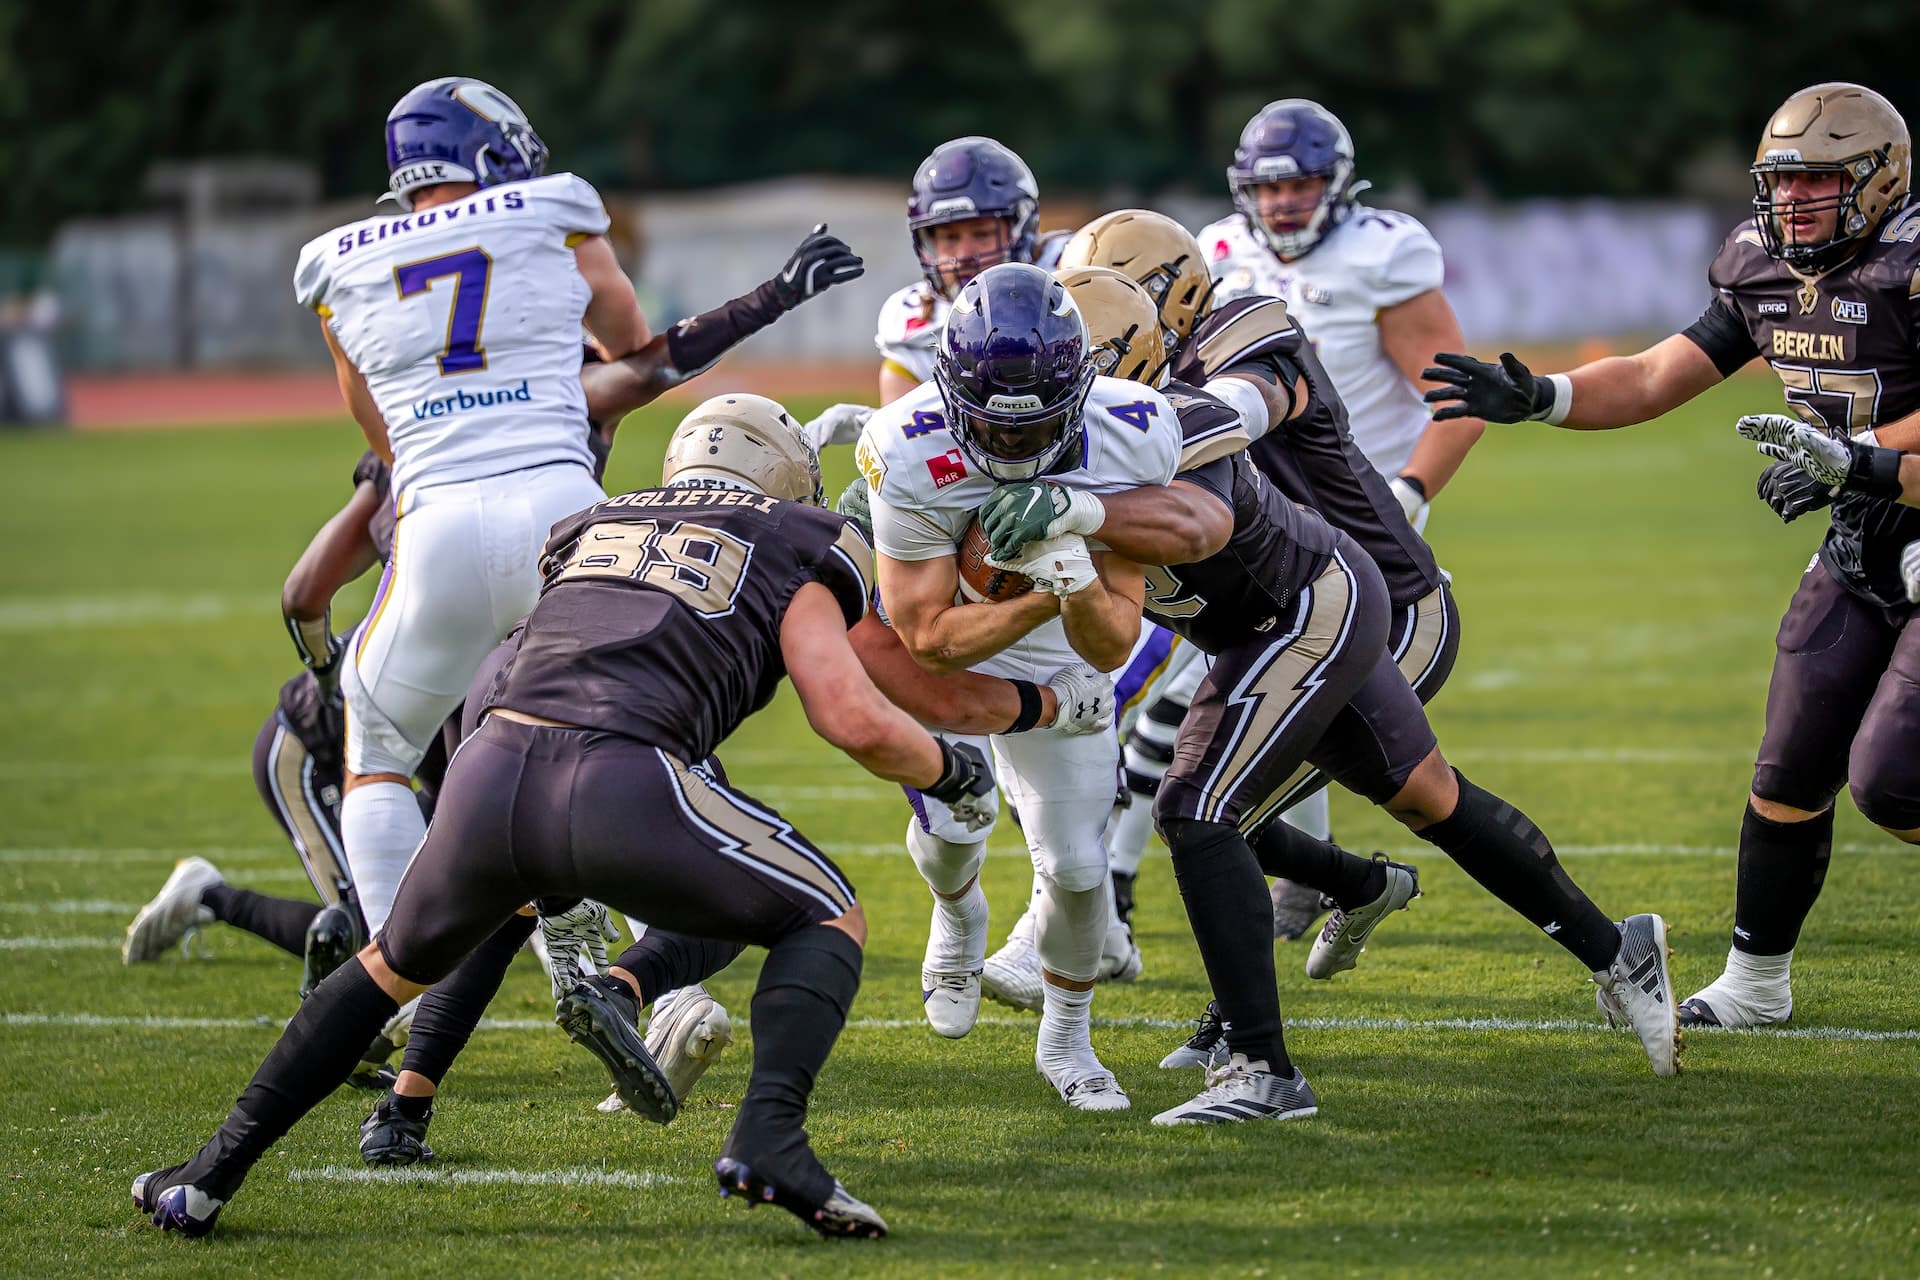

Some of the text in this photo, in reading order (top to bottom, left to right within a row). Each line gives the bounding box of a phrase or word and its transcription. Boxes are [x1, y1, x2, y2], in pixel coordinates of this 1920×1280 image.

[394, 246, 494, 377] 7
[1758, 303, 1787, 313] KPRO
[1836, 303, 1866, 319] AFLE
[1773, 328, 1845, 361] BERLIN
[413, 380, 532, 420] Verbund
[991, 401, 1037, 409] FORELLE
[901, 409, 946, 440] 4
[1105, 400, 1159, 434] 4
[936, 472, 960, 488] R4R
[555, 518, 755, 619] 89
